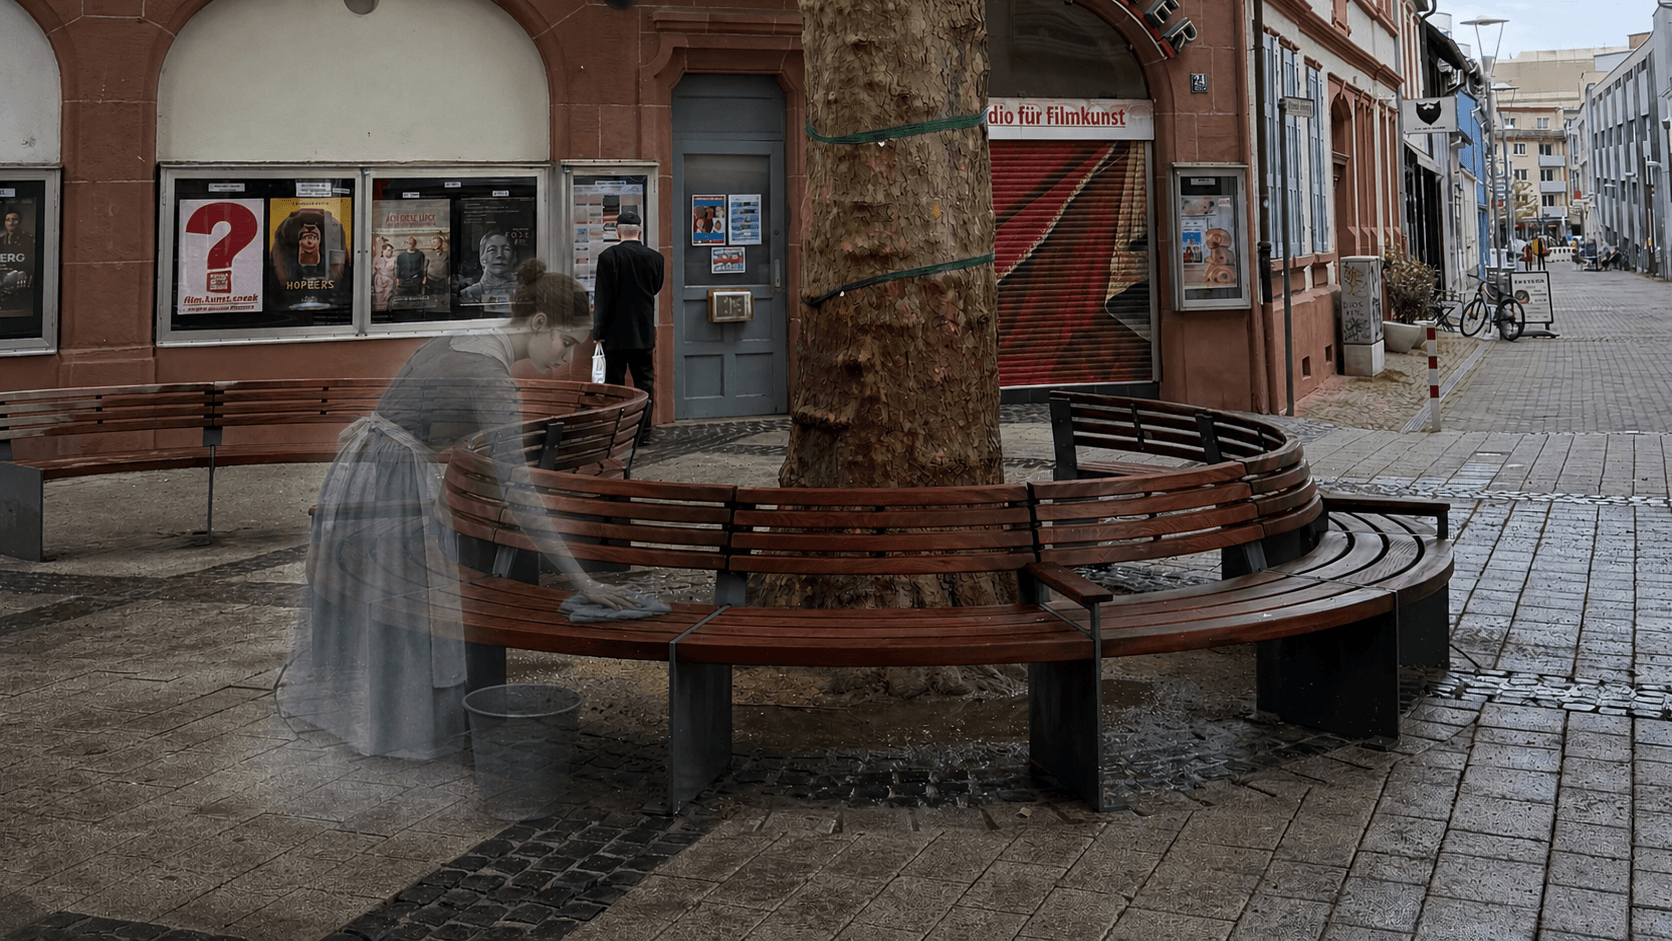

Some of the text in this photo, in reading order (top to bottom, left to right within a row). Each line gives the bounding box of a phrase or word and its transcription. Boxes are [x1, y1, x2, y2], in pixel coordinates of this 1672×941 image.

[988, 105, 1126, 126] dio für Filmkunst
[0, 252, 26, 263] ERG
